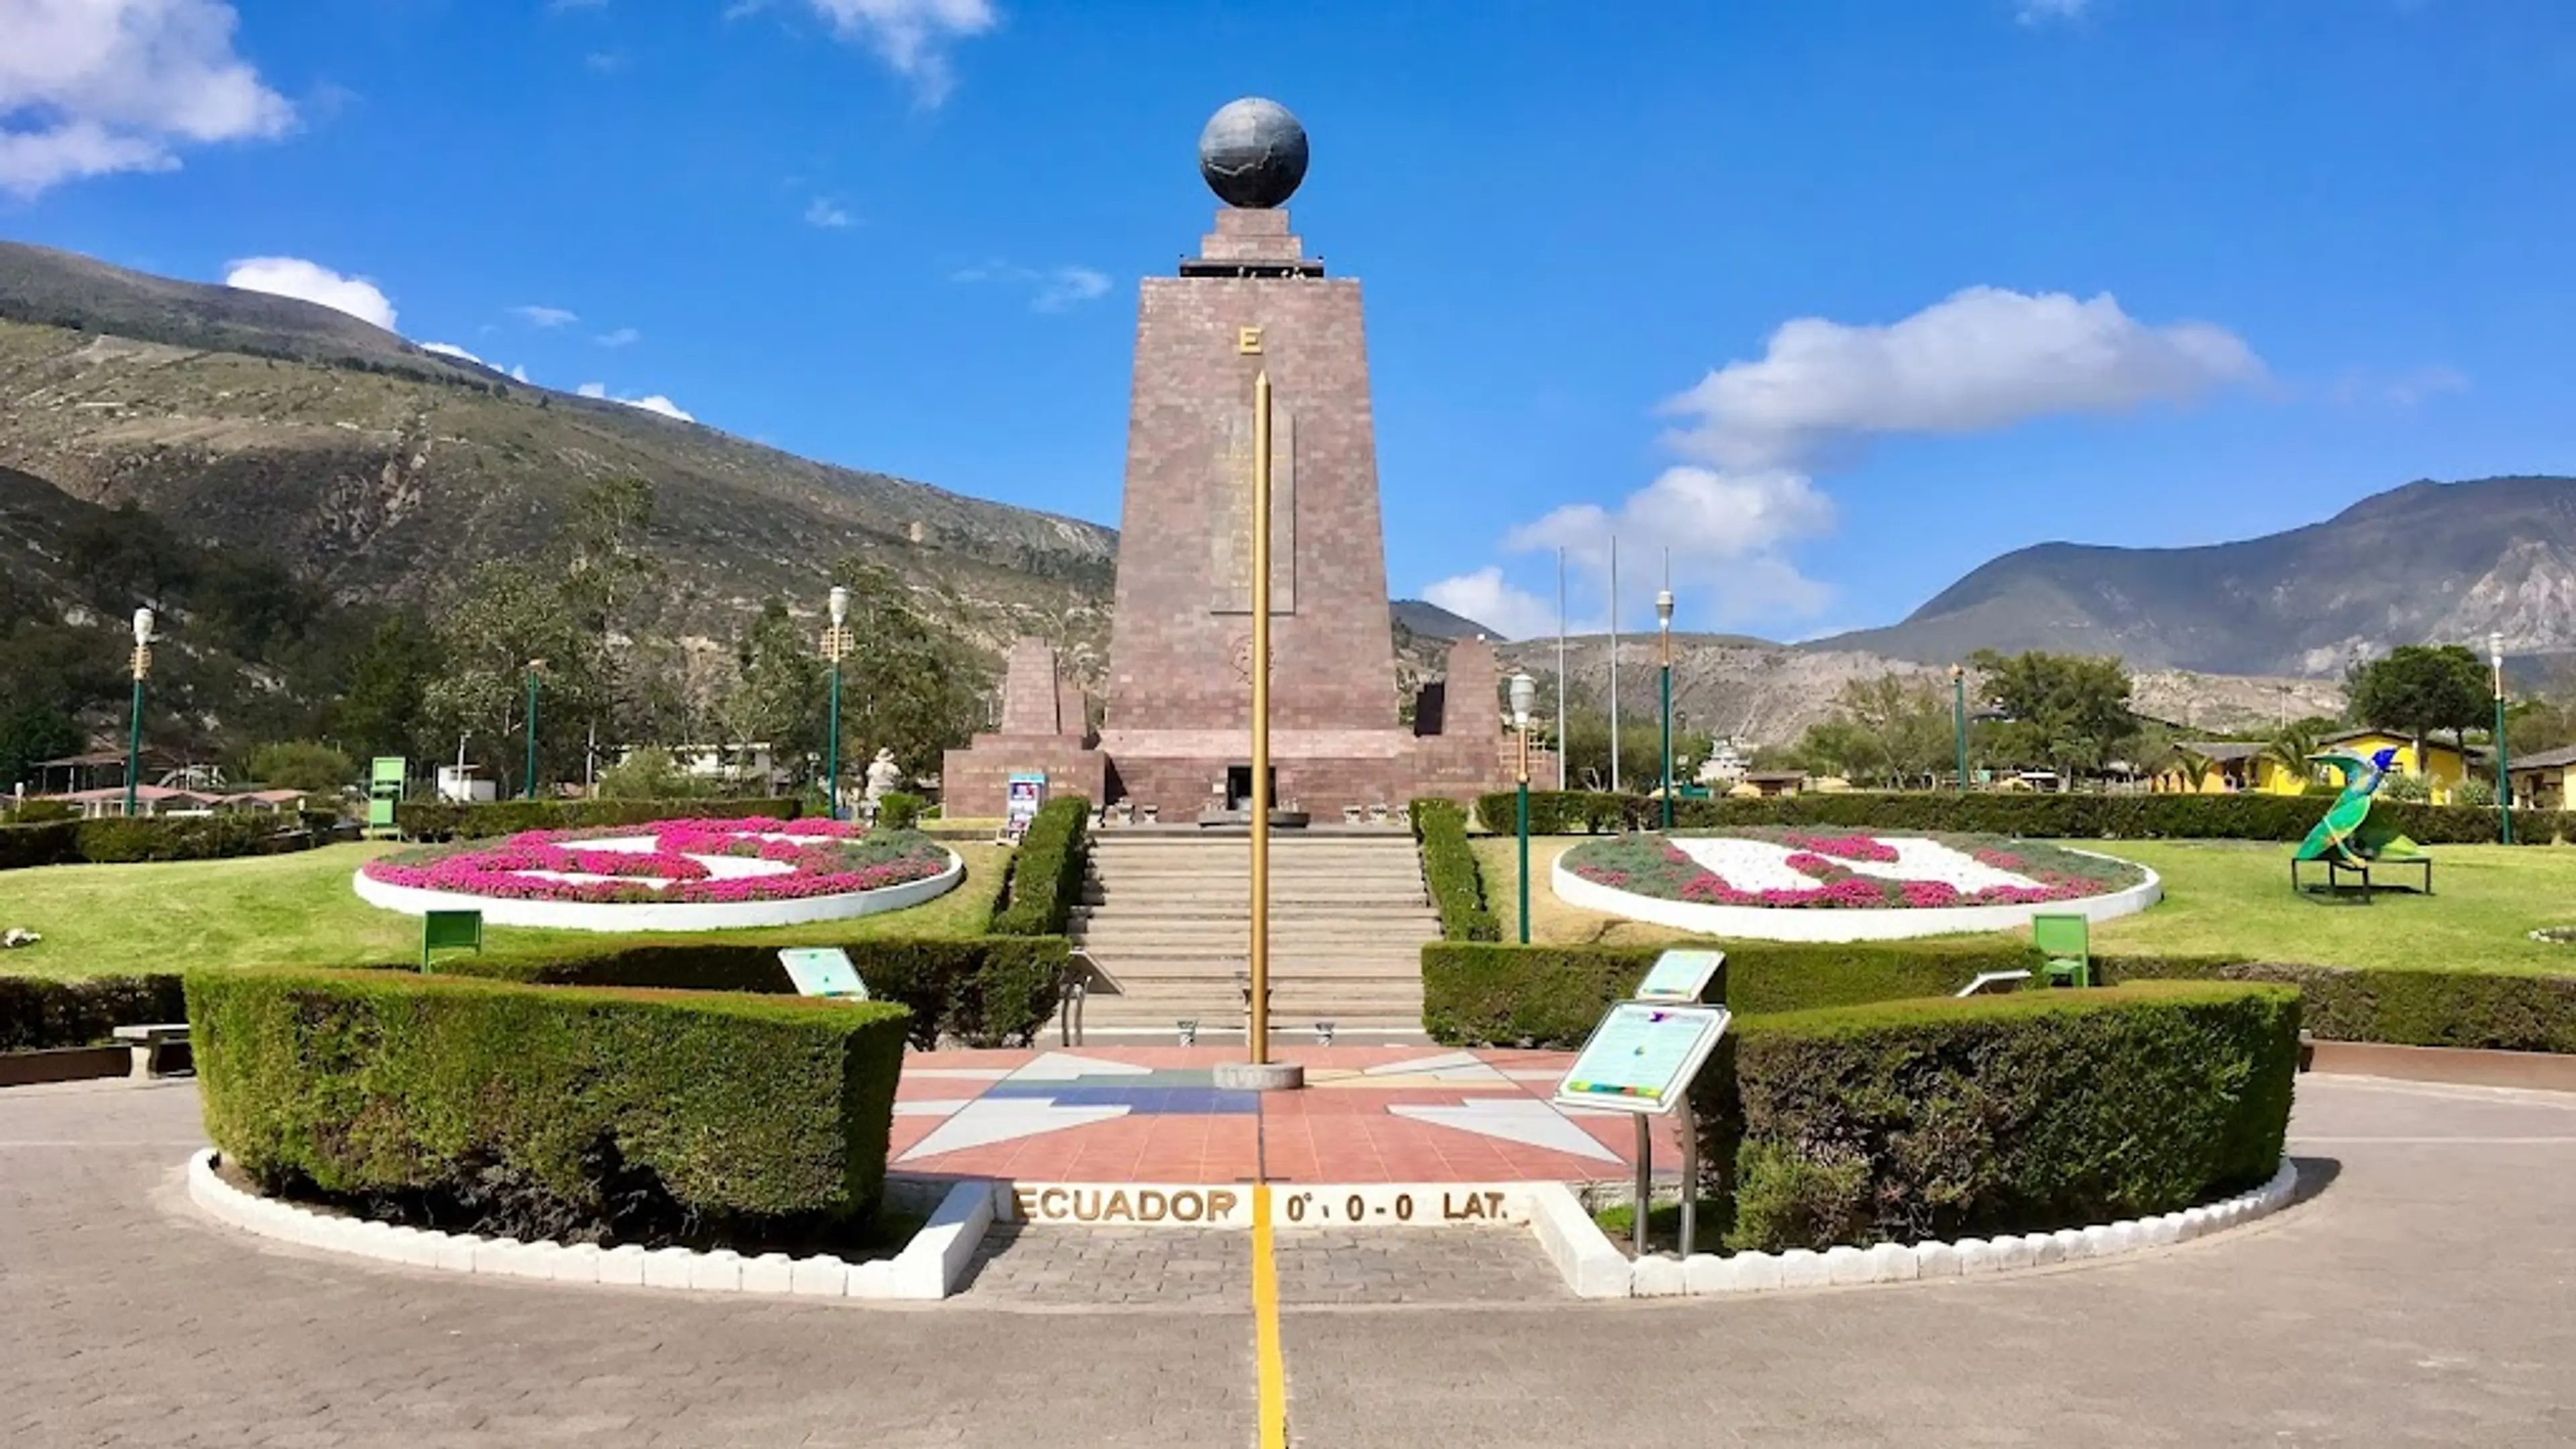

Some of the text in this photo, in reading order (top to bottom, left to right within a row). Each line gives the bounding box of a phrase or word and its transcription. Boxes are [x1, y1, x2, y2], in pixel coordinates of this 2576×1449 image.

[1240, 326, 1263, 354] E
[1015, 1187, 1237, 1222] ECUADOR
[1443, 1192, 1507, 1219] LAT.
